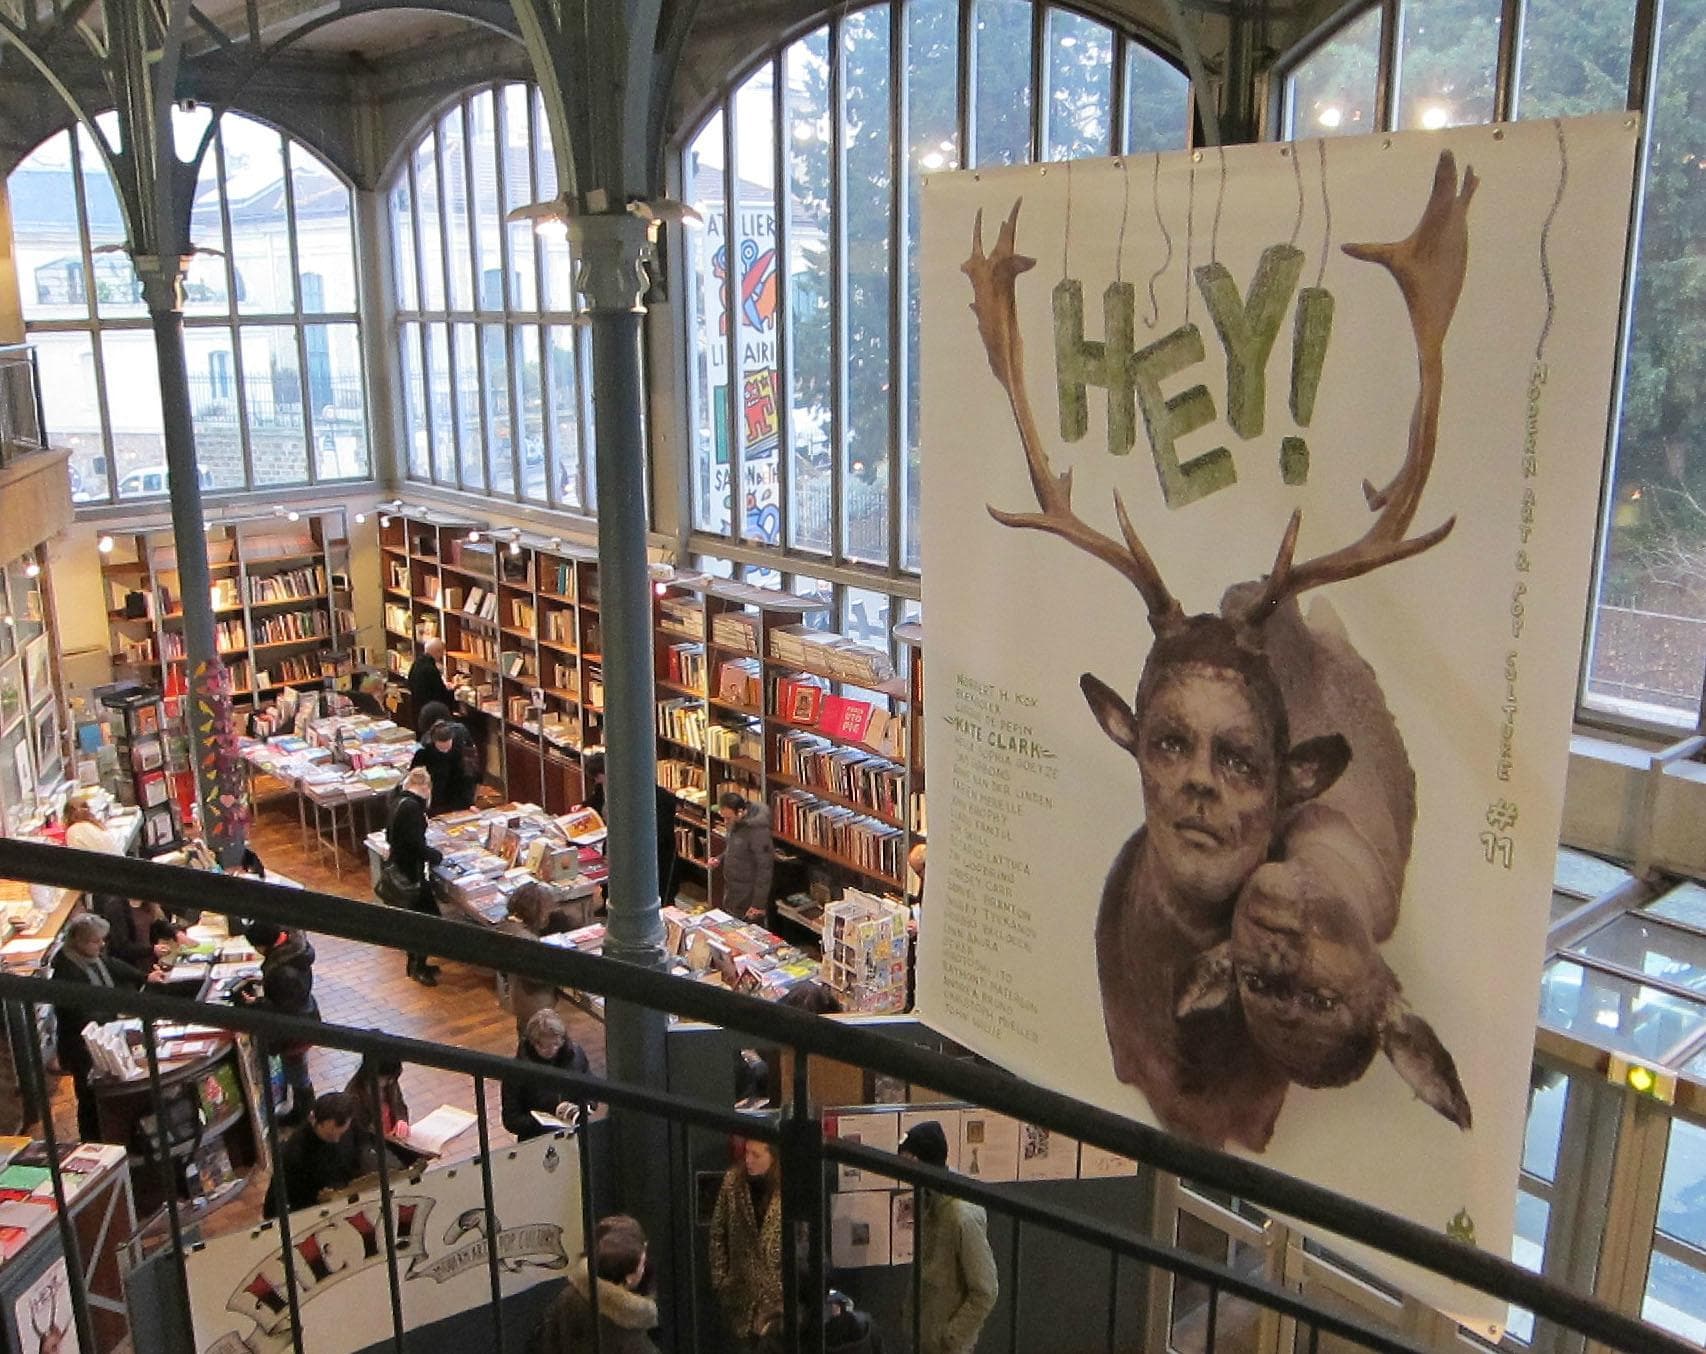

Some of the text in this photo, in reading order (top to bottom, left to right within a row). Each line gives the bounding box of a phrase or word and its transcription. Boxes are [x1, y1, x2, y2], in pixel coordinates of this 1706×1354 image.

[707, 213, 776, 236] ATLIER
[711, 342, 777, 366] LIAIRI
[1052, 244, 1335, 510] HEY!
[956, 718, 983, 742] KATE
[988, 731, 1040, 758] CLARK
[1481, 831, 1514, 871] 11
